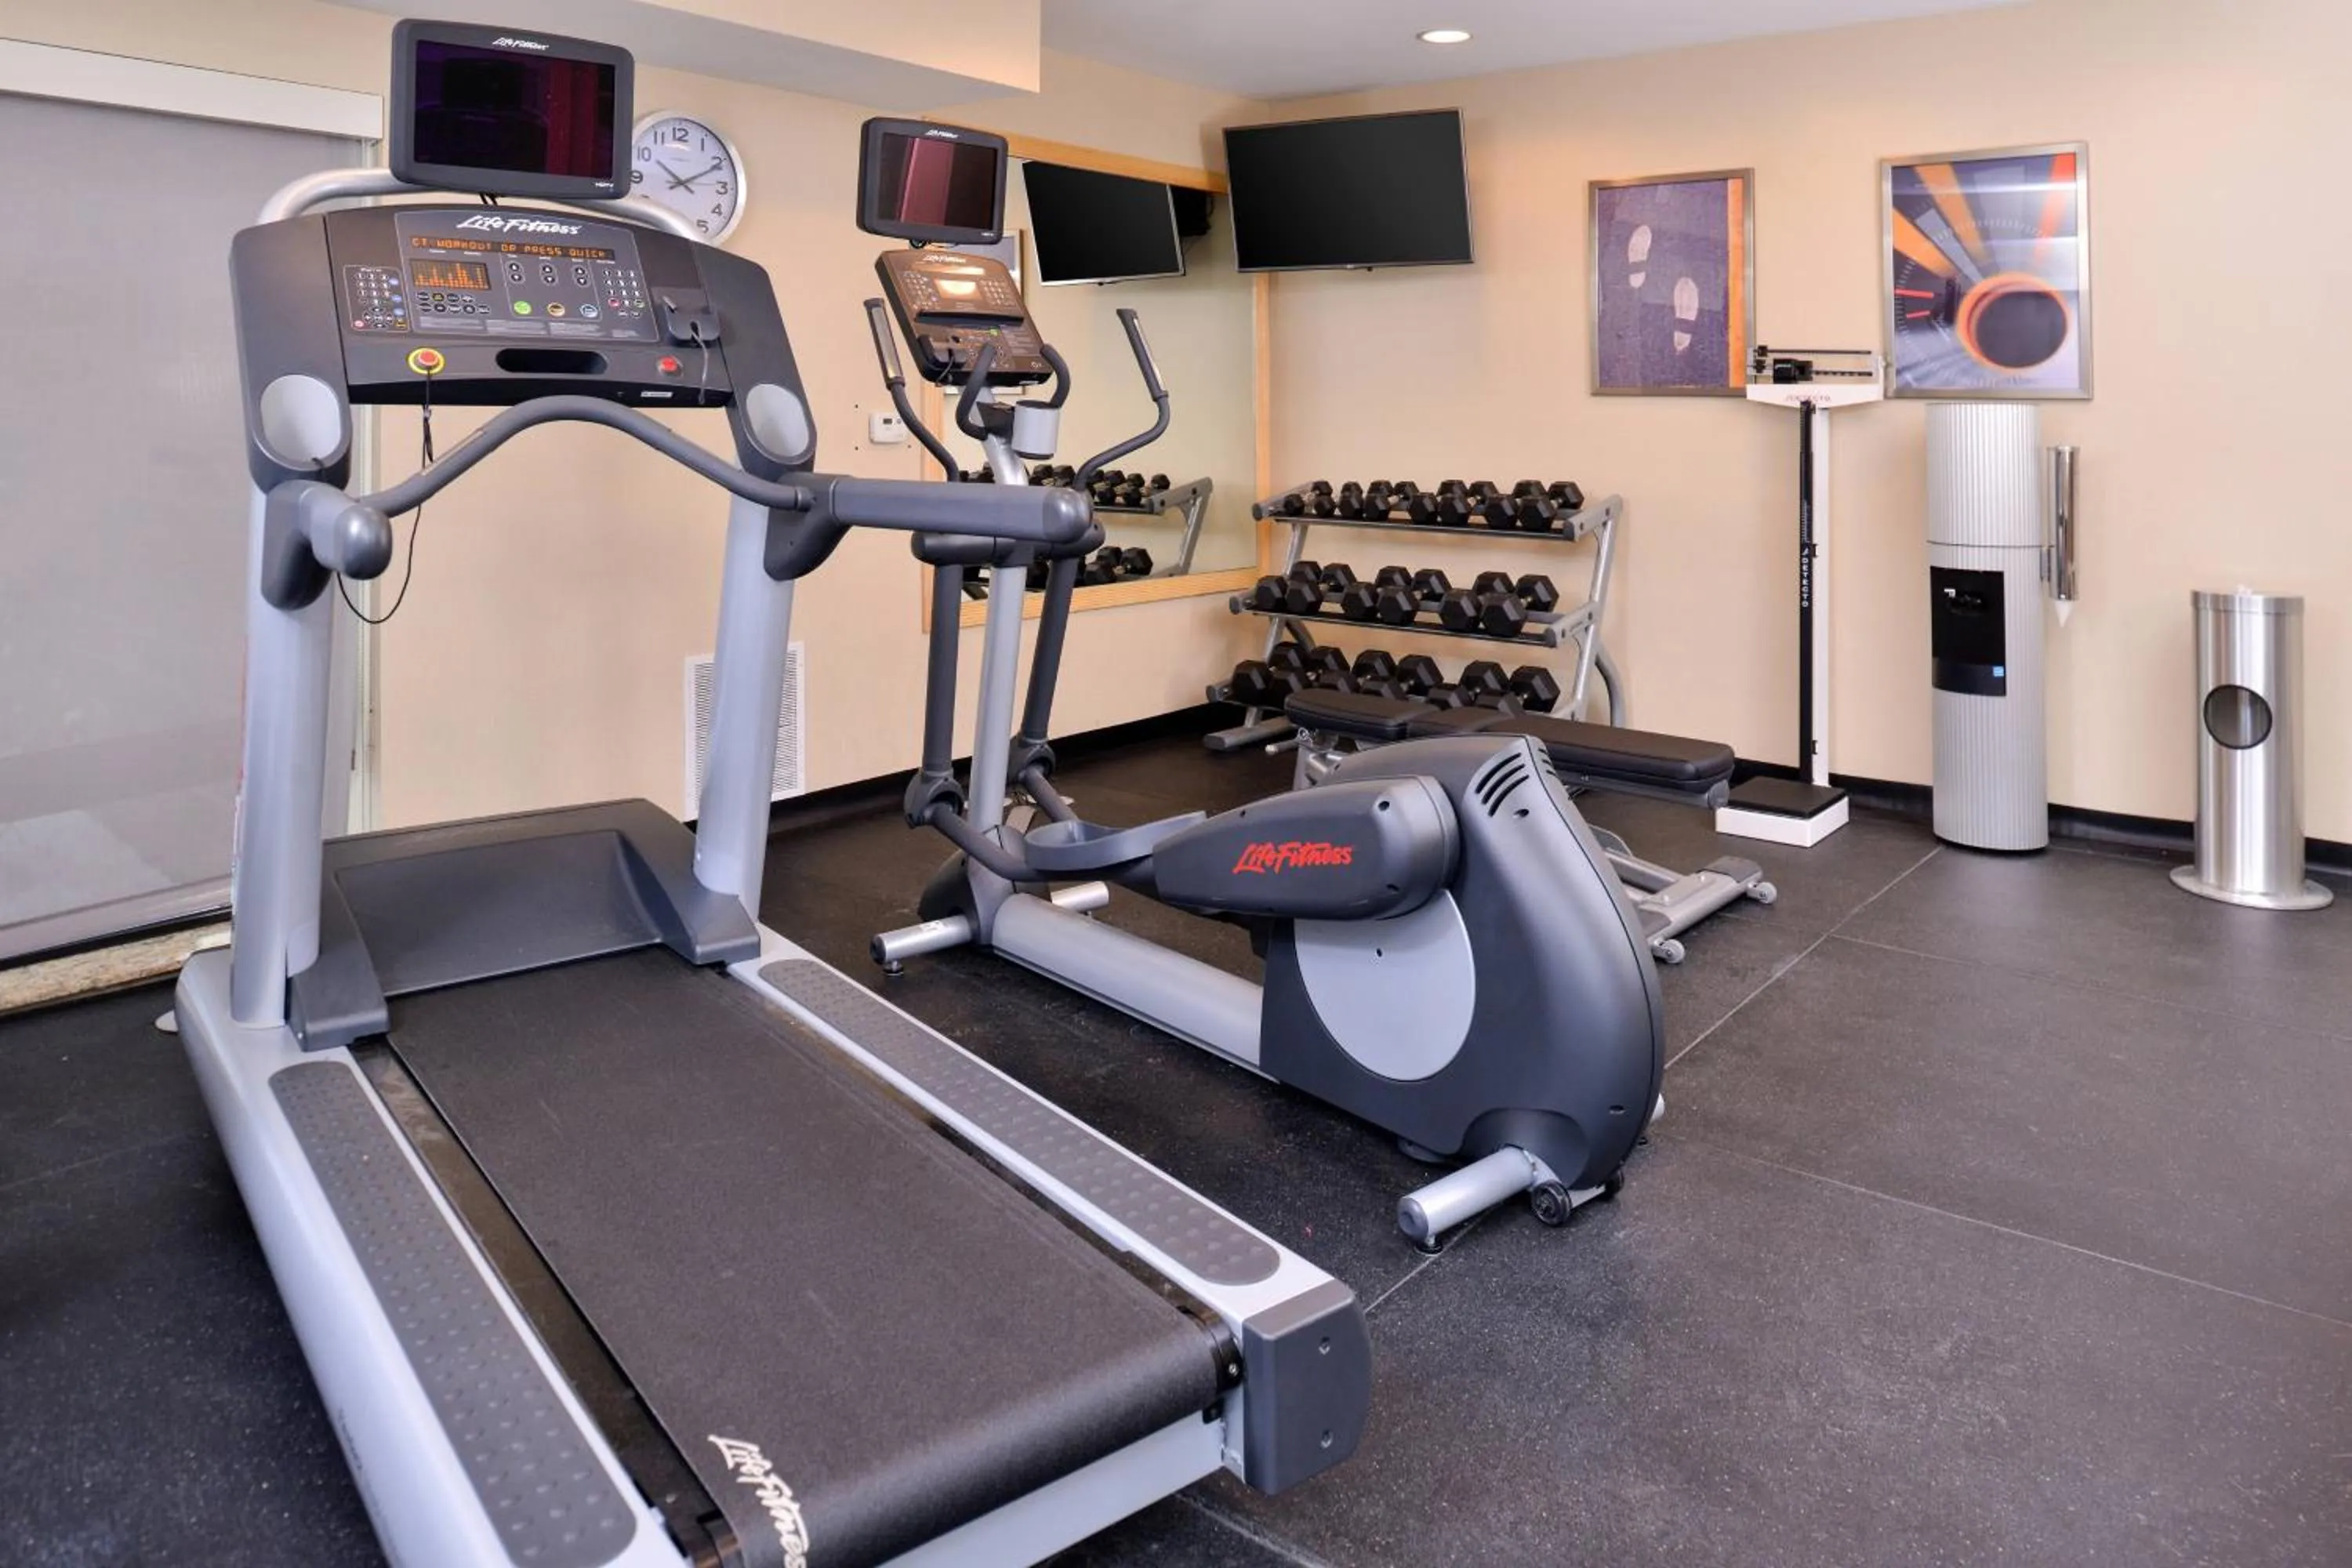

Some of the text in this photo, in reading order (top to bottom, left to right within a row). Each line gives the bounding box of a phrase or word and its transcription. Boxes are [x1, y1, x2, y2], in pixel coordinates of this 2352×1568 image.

[653, 130, 666, 145] 11
[672, 127, 689, 143] 12
[700, 137, 706, 151] 1
[637, 146, 652, 162] 10
[711, 156, 724, 171] 2
[630, 169, 644, 183] 9
[715, 181, 728, 195] 3
[711, 203, 723, 216] 4
[696, 220, 710, 234] 5
